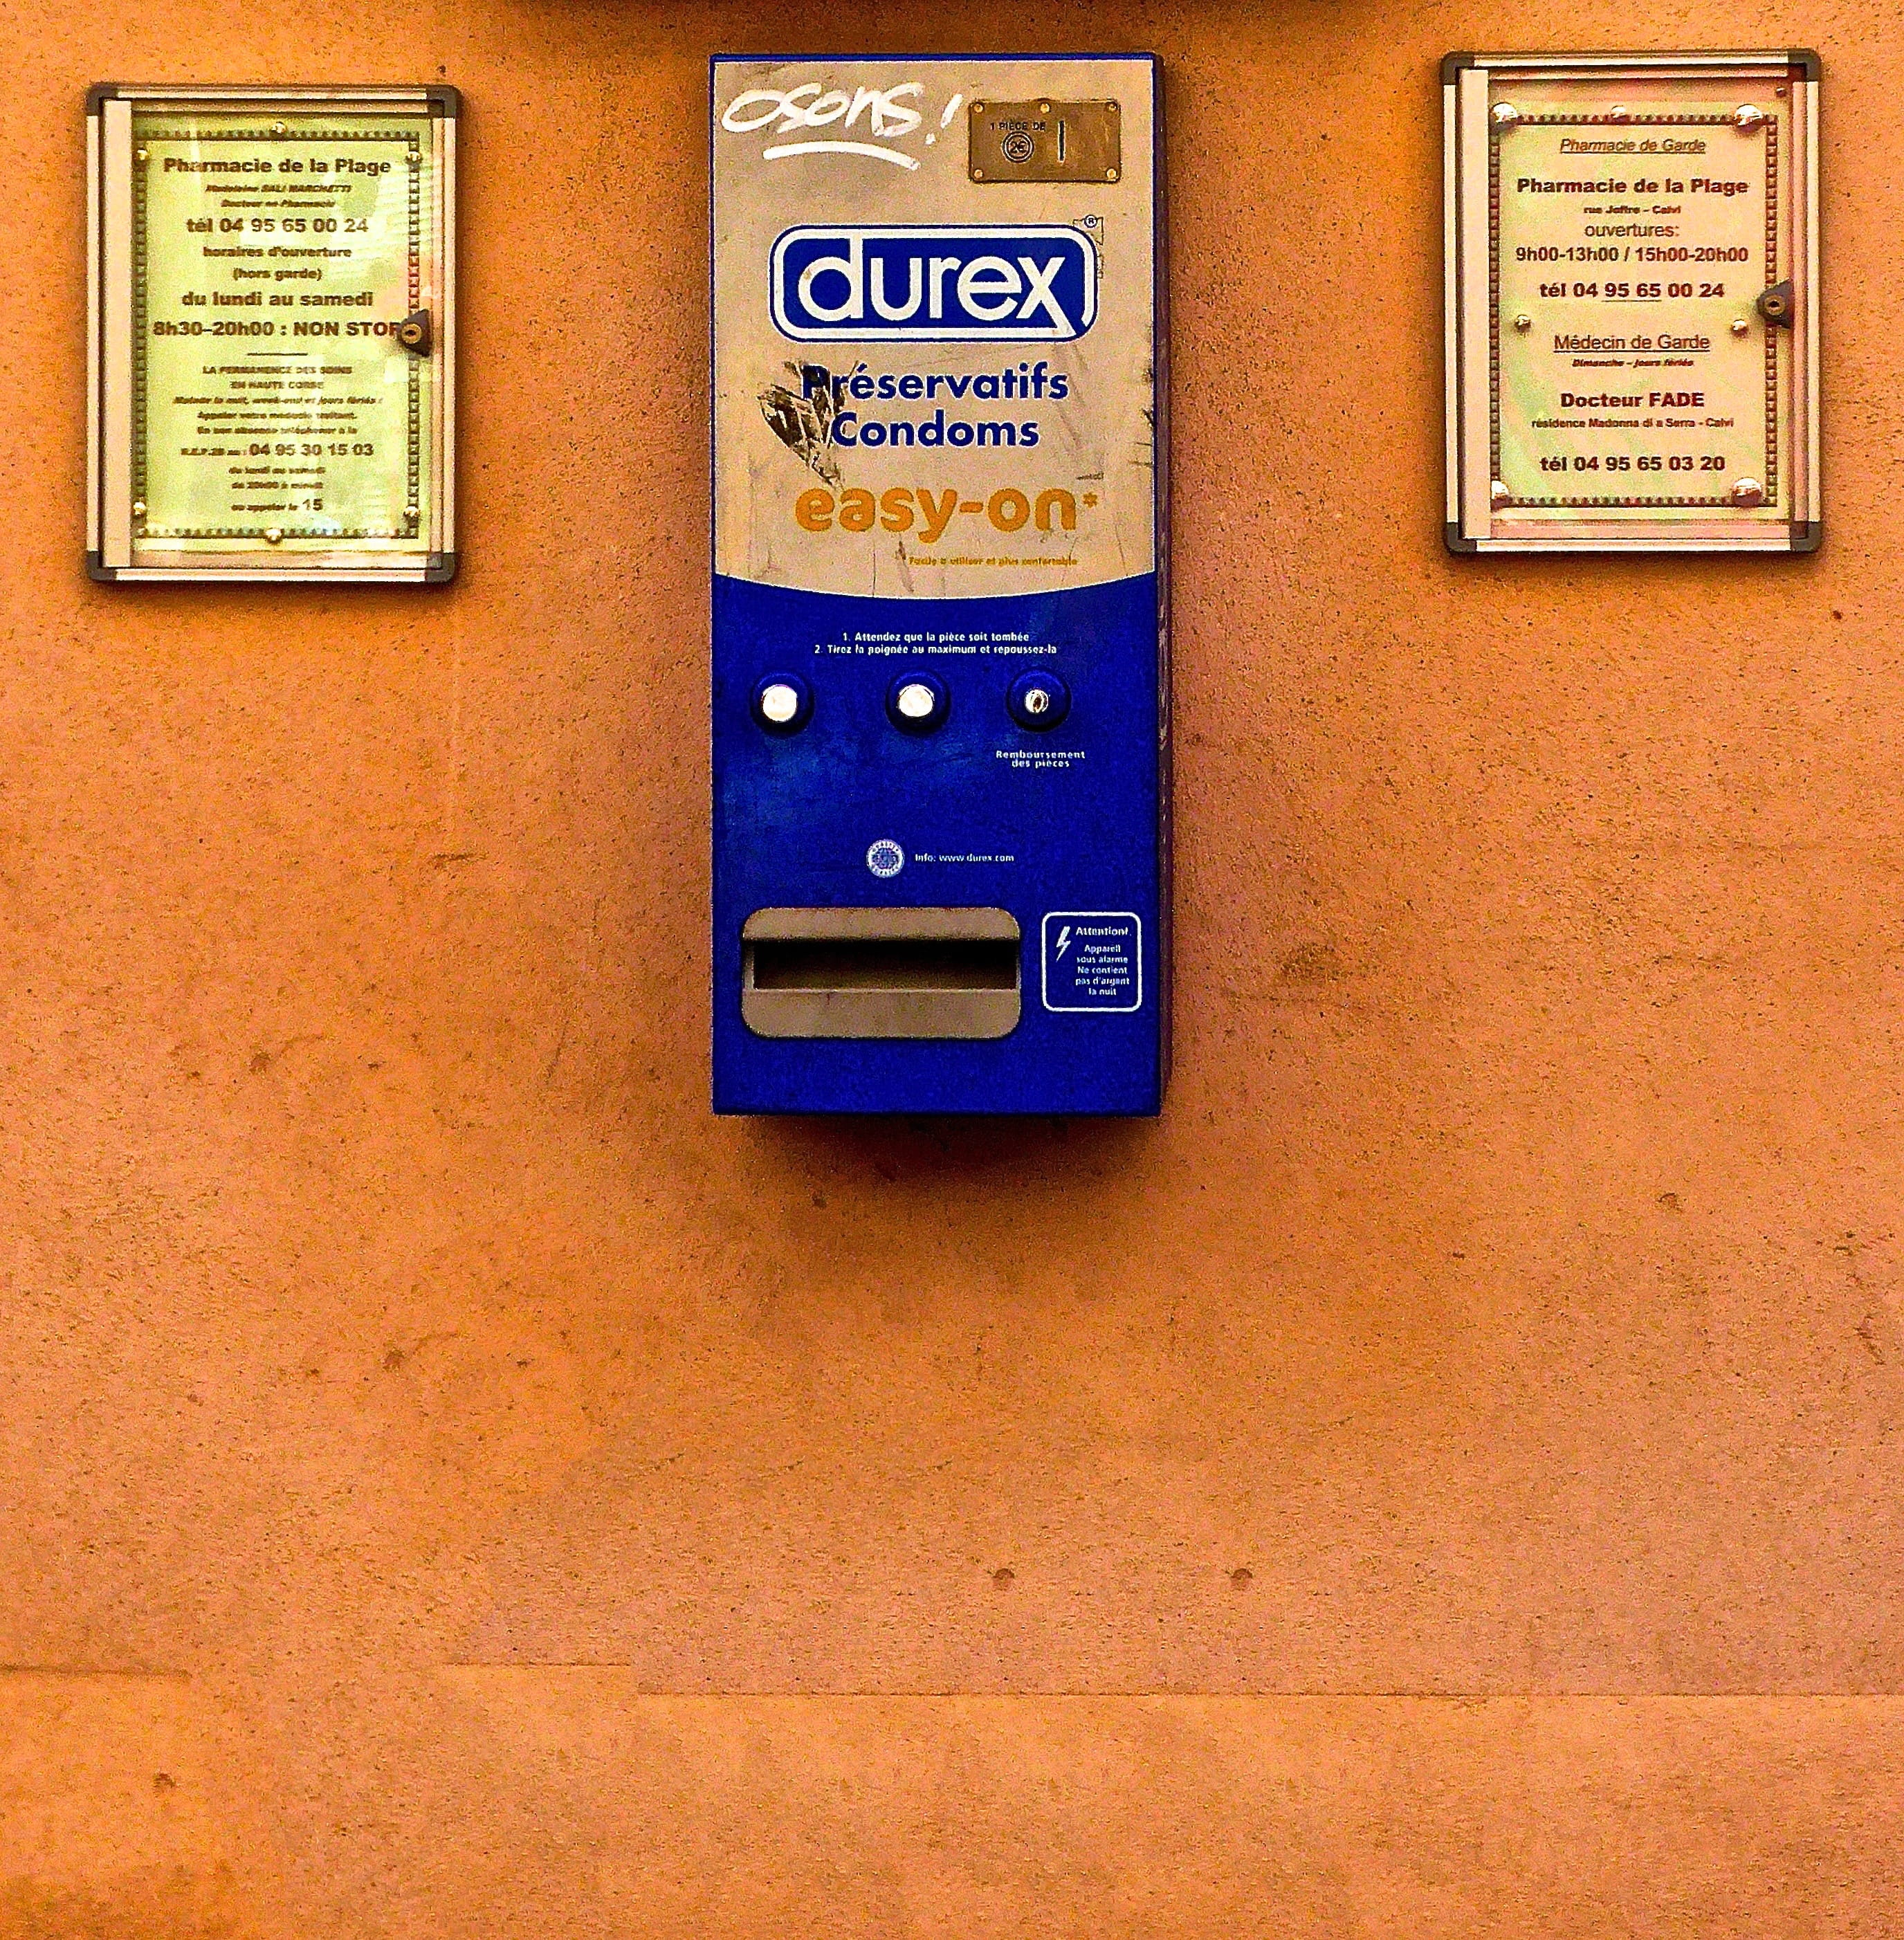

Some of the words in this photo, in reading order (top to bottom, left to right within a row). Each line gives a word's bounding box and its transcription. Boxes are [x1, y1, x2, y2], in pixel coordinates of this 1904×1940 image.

[1033, 122, 1045, 131] DE
[1561, 138, 1635, 152] Pharmacie
[1640, 138, 1657, 152] de
[1663, 138, 1706, 152] Garde
[164, 158, 272, 172] Pharmacie
[278, 158, 303, 172] de
[310, 158, 328, 172] la
[336, 158, 391, 176] Plage
[1517, 179, 1627, 192] Pharmacie
[1633, 179, 1658, 193] de
[1665, 179, 1683, 193] la
[1691, 179, 1749, 196] Plage
[186, 218, 213, 232] tél
[219, 218, 244, 232] 04
[251, 218, 275, 232] 95
[282, 218, 306, 232] 65
[313, 218, 337, 232] 00
[345, 218, 368, 232] 24
[1584, 223, 1679, 237] ouvertures:
[203, 246, 264, 257] horaires
[1516, 247, 1619, 262] 9h00-13h00
[1636, 247, 1748, 262] 15h00-20h00
[232, 268, 271, 281] (hors
[275, 268, 322, 282] garde)
[798, 236, 1071, 325] durex
[1540, 283, 1566, 297] tél
[1573, 283, 1598, 298] 04
[1605, 283, 1629, 298] 95
[1636, 283, 1661, 298] 65
[1668, 283, 1692, 298] 00
[1699, 284, 1724, 298] 24
[182, 291, 206, 306] du
[213, 291, 262, 306] lundi
[269, 295, 293, 306] au
[300, 292, 373, 306] samedi
[293, 322, 339, 336] NON
[1554, 335, 1626, 349] Médecin
[1631, 335, 1651, 349] de
[1658, 335, 1710, 349] Garde
[203, 366, 217, 374] LA
[248, 381, 284, 390] HAUTE
[803, 360, 1069, 401] Préservatifs
[1561, 393, 1643, 408] Docteur
[1649, 392, 1704, 407] FADE
[830, 410, 1039, 448] Condoms
[1532, 419, 1586, 428] résidence
[1589, 418, 1639, 428] Madonna
[1665, 418, 1695, 427] Serra
[1705, 418, 1734, 427] Calvi
[249, 443, 271, 456] 04
[301, 443, 322, 456] 30
[328, 443, 347, 456] 15
[352, 443, 374, 456] 03
[1539, 457, 1566, 471] tél
[1573, 457, 1599, 471] 04
[1606, 457, 1631, 471] 95
[1638, 457, 1662, 470] 65
[1669, 457, 1694, 470] 03
[1701, 456, 1725, 470] 20
[303, 498, 323, 511] 15
[855, 632, 900, 641] Attendez
[904, 634, 922, 643] que
[926, 632, 935, 641] la
[940, 632, 965, 643] pièce
[969, 632, 987, 641] soit
[991, 632, 1029, 641] tombée
[827, 645, 851, 653] Tirez
[855, 644, 863, 653] la
[868, 644, 908, 656] poignée
[928, 645, 976, 653] maximum
[994, 644, 1056, 655] repoussez-la
[996, 750, 1086, 759] Remboursement
[1035, 759, 1070, 769] pièces
[915, 853, 935, 861] Info:
[1084, 944, 1120, 954] Appareil
